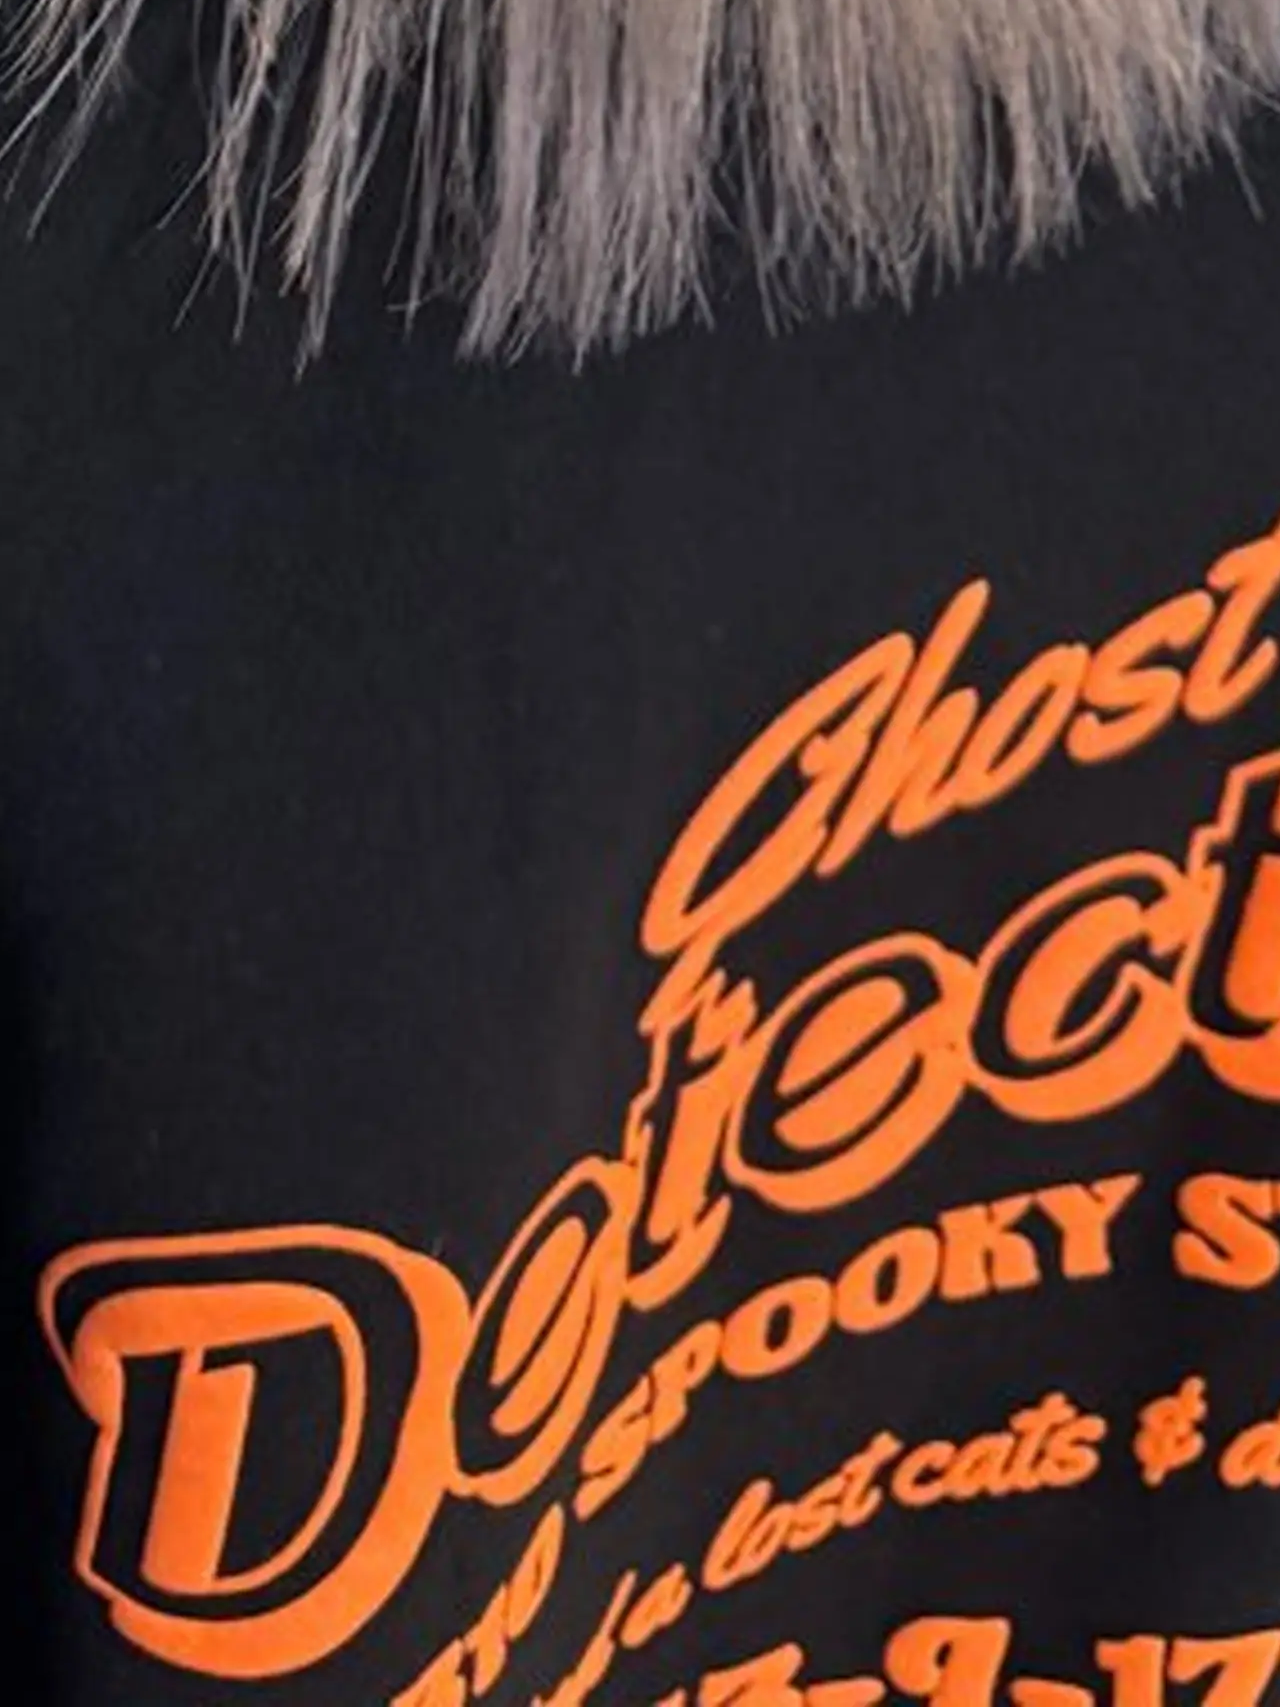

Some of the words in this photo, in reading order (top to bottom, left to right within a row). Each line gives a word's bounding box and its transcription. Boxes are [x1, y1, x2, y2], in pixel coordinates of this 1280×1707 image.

[573, 1175, 1141, 1521] SPOOKY
[702, 1432, 902, 1591] lost
[892, 1391, 1108, 1507] cats
